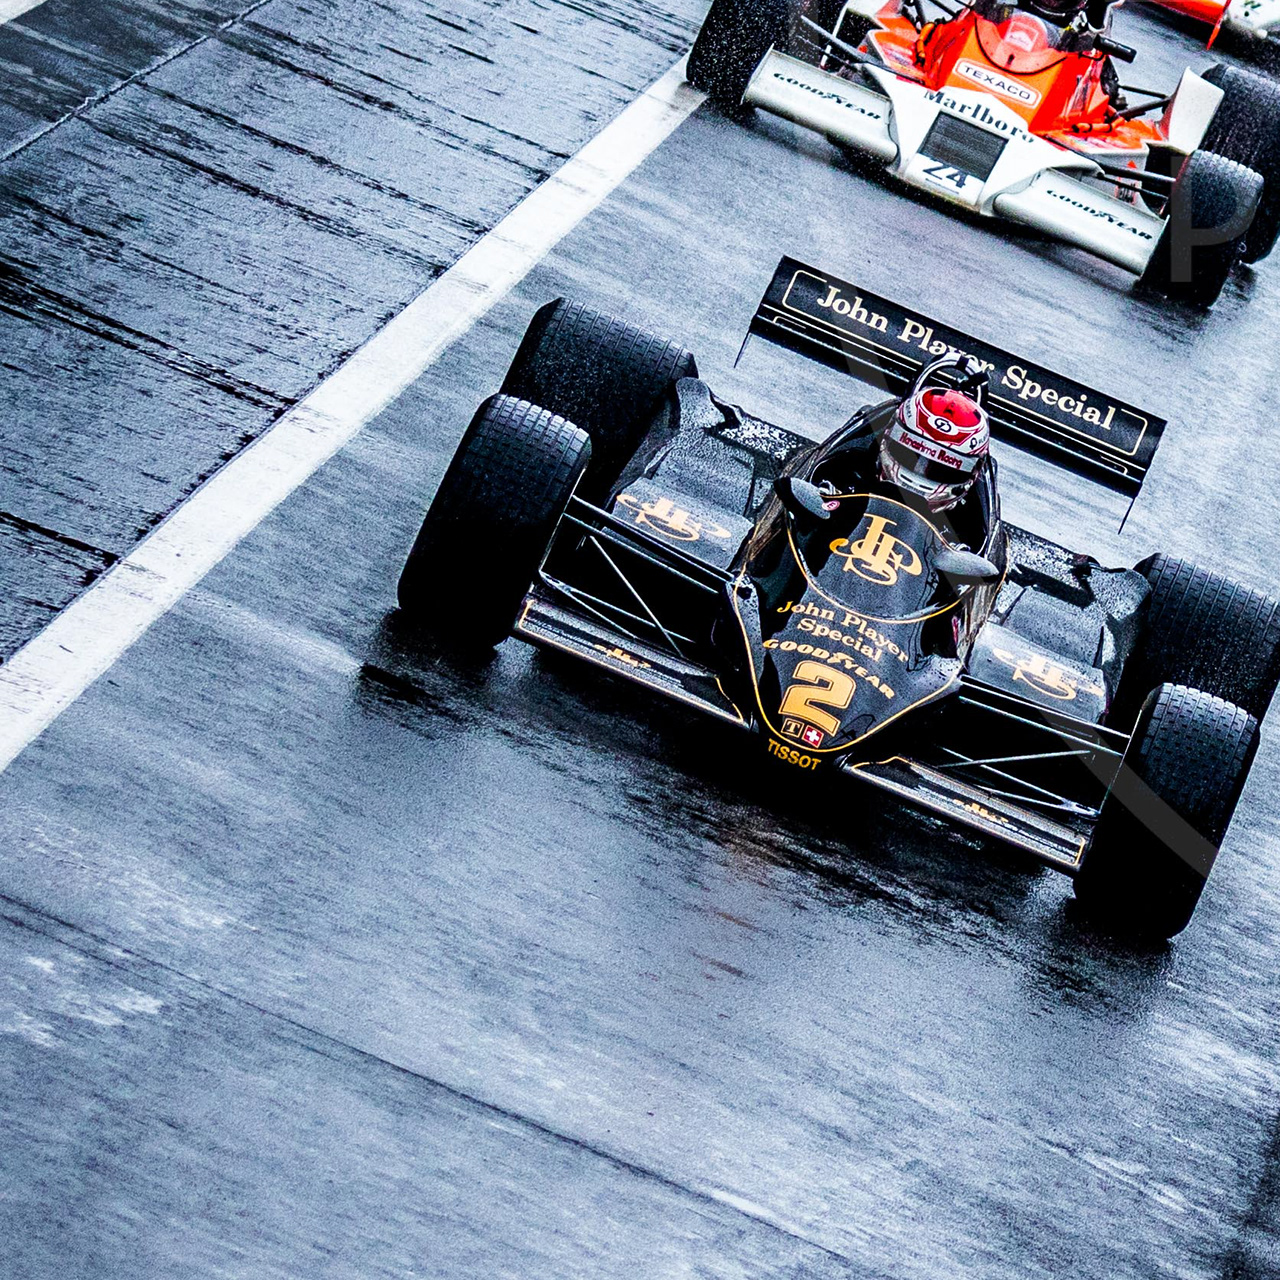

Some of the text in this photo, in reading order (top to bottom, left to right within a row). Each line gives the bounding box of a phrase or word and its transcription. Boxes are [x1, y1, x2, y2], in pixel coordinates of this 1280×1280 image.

[961, 66, 1032, 102] TEXACO
[923, 87, 1036, 145] Marlboro
[816, 287, 888, 334] John
[1001, 365, 1116, 431] Special
[937, 448, 963, 470] Racing
[777, 600, 909, 664] John Player
[797, 617, 883, 663] Special
[778, 659, 857, 738] 2
[767, 737, 822, 771] TISSOT
